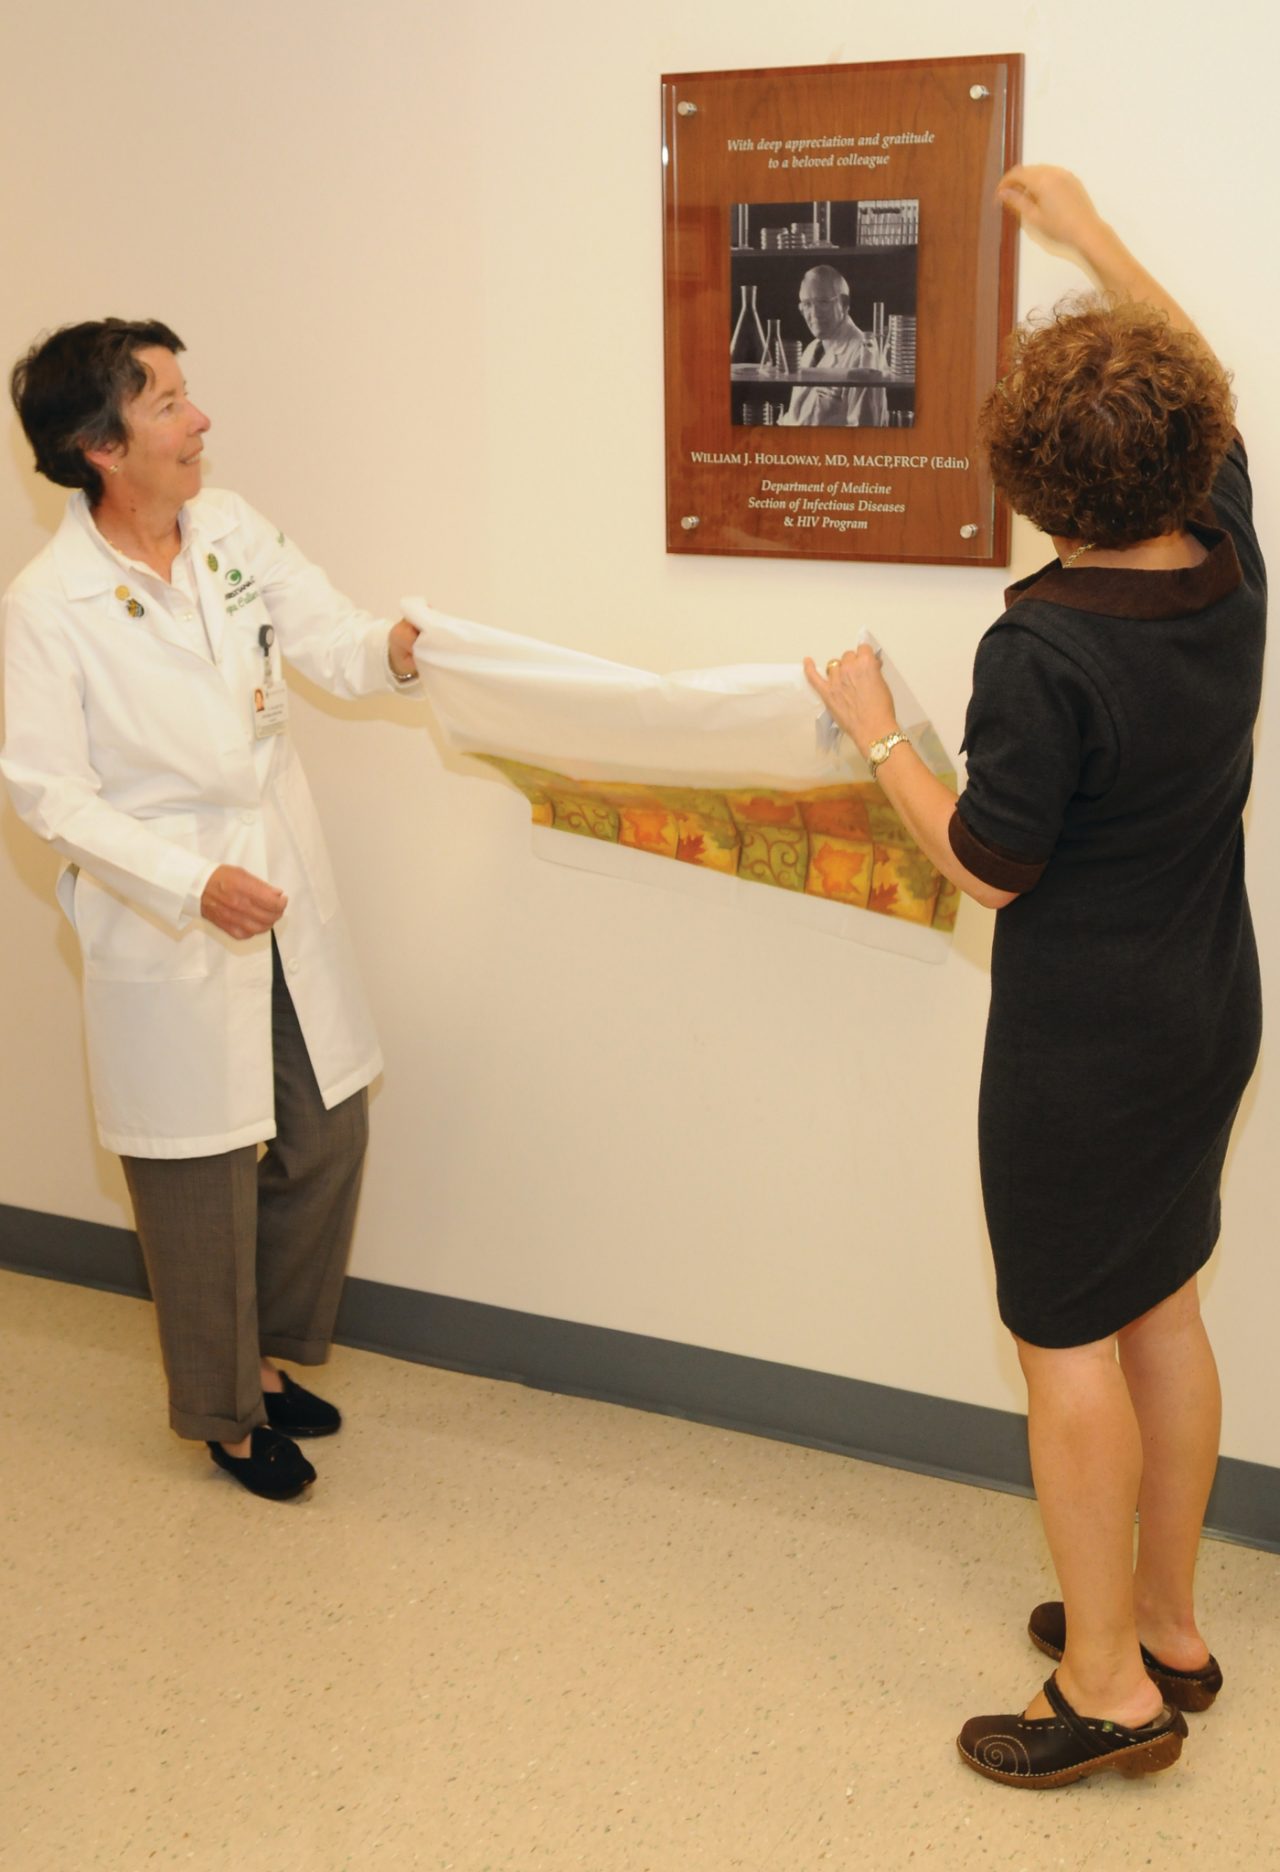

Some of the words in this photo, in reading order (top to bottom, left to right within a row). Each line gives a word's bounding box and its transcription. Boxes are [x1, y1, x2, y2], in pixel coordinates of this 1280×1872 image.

[727, 138, 754, 152] With
[757, 138, 782, 153] deep
[785, 135, 854, 152] appreciation
[858, 133, 880, 146] and
[881, 131, 935, 149] gratitude
[768, 157, 779, 168] to
[782, 159, 789, 168] a
[791, 154, 834, 168] beloved
[837, 153, 890, 169] colleague
[691, 451, 741, 464] WILLIAM
[743, 452, 752, 466] J.
[755, 453, 822, 466] HOLLOWAY,
[825, 454, 850, 468] MD,
[853, 455, 928, 469] MACP,FRCP
[930, 456, 969, 470] (Edin)
[761, 479, 825, 494] Department
[827, 481, 840, 496] of
[840, 482, 892, 495] Medicine
[748, 496, 786, 509] Section
[789, 498, 801, 512] of
[802, 498, 855, 513] Infectious
[858, 500, 906, 513] Diseases
[783, 516, 794, 527] &
[796, 516, 820, 528] HIV
[822, 516, 868, 532] Program
